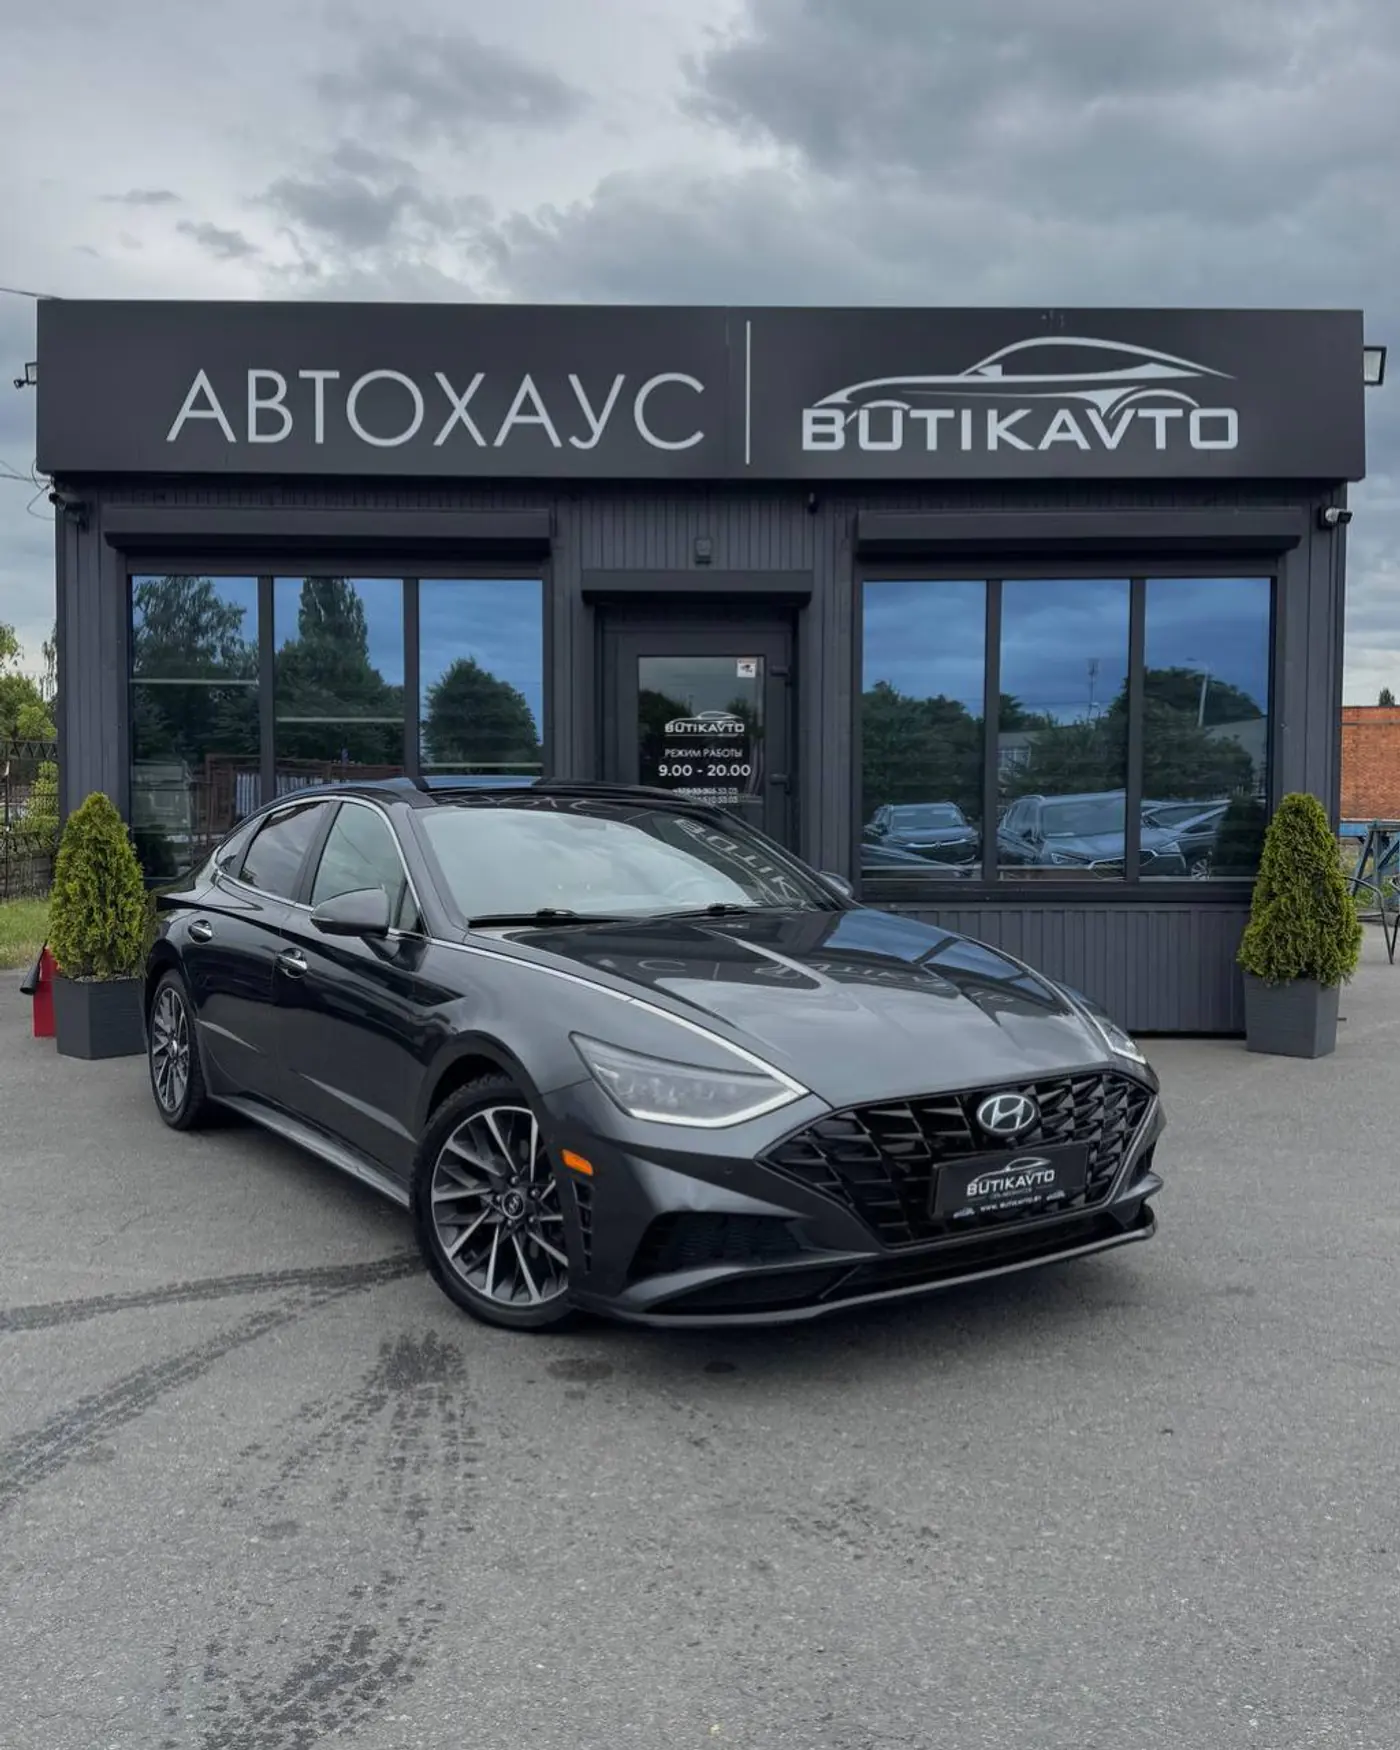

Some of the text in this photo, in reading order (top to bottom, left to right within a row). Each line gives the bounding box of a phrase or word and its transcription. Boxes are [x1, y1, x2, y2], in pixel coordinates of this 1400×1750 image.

[167, 368, 705, 450] АВТОХАУС
[803, 407, 1239, 451] BUTIKAVTO
[664, 723, 745, 733] BUTIKAVTO
[664, 749, 742, 758] РЕЖИМ РАБОТЫ
[658, 764, 693, 776] 9.00
[708, 764, 751, 776] 20.00
[966, 1170, 1055, 1197] BUTIKAVTO
